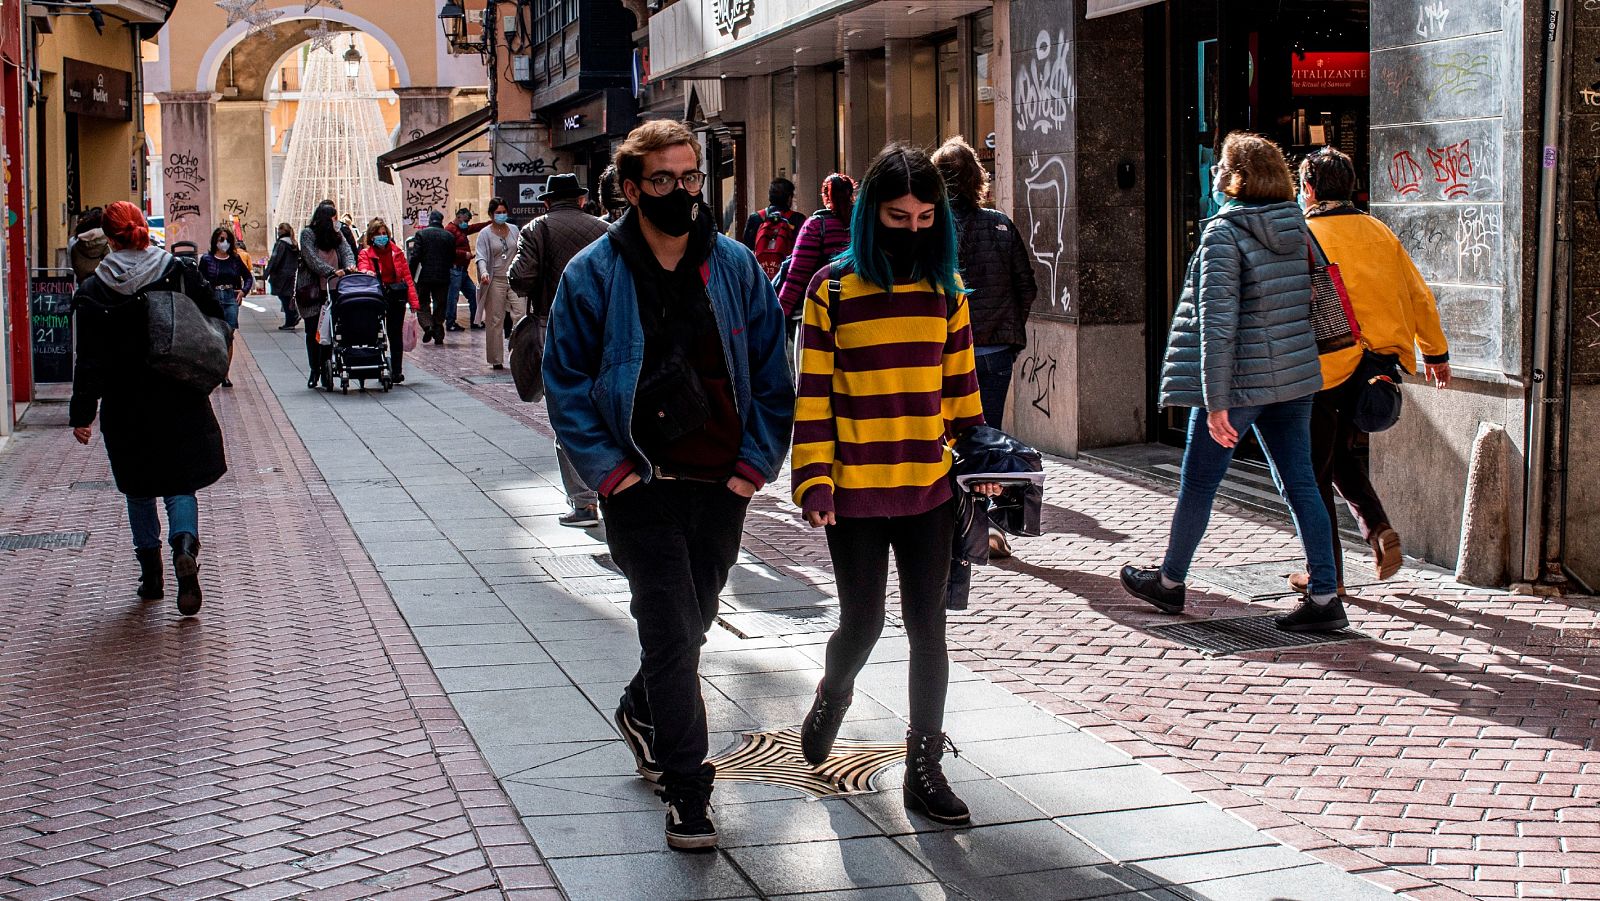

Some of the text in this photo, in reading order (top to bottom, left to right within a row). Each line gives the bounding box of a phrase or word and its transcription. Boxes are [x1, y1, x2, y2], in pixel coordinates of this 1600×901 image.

[564, 114, 580, 131] MAC
[33, 294, 57, 312] 17
[36, 328, 54, 343] 21
